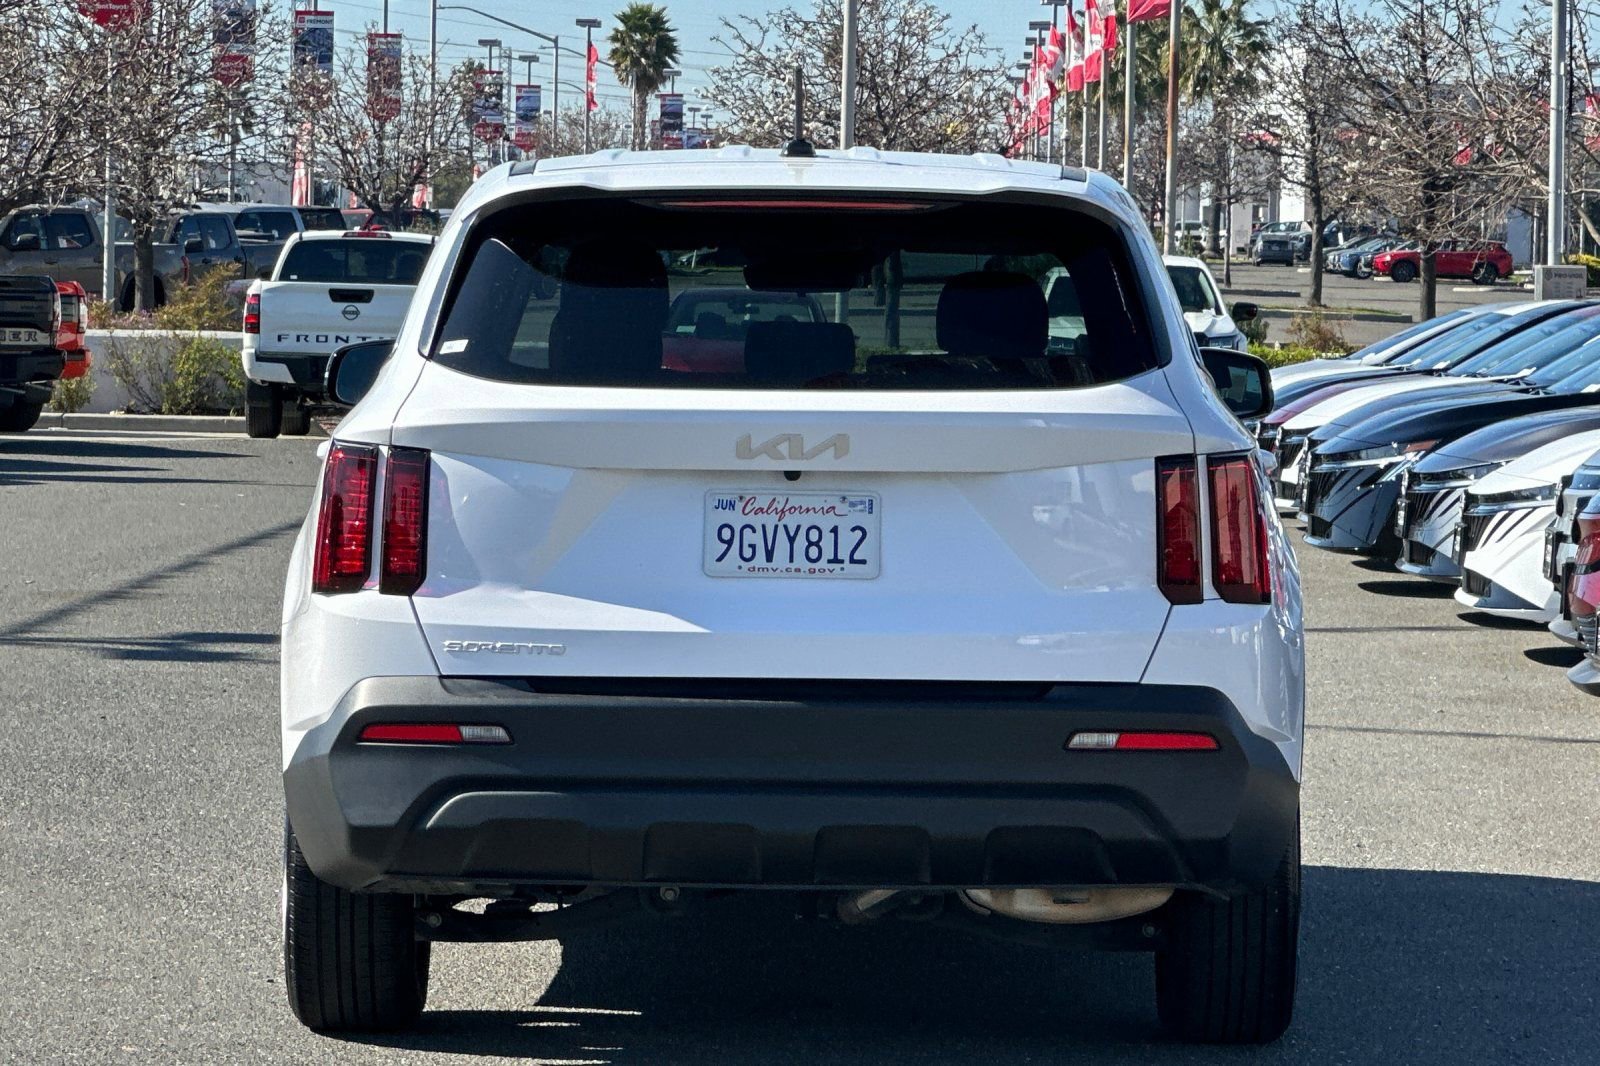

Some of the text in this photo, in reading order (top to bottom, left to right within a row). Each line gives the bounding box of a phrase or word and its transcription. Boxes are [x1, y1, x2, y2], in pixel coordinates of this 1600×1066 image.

[277, 333, 397, 344] FRONT
[736, 433, 850, 460] KIA
[714, 498, 736, 511] JUN
[741, 496, 849, 522] California
[715, 523, 868, 565] 9GVY812
[747, 565, 836, 575] dmv.ca.gov
[442, 640, 567, 656] SORENTO
